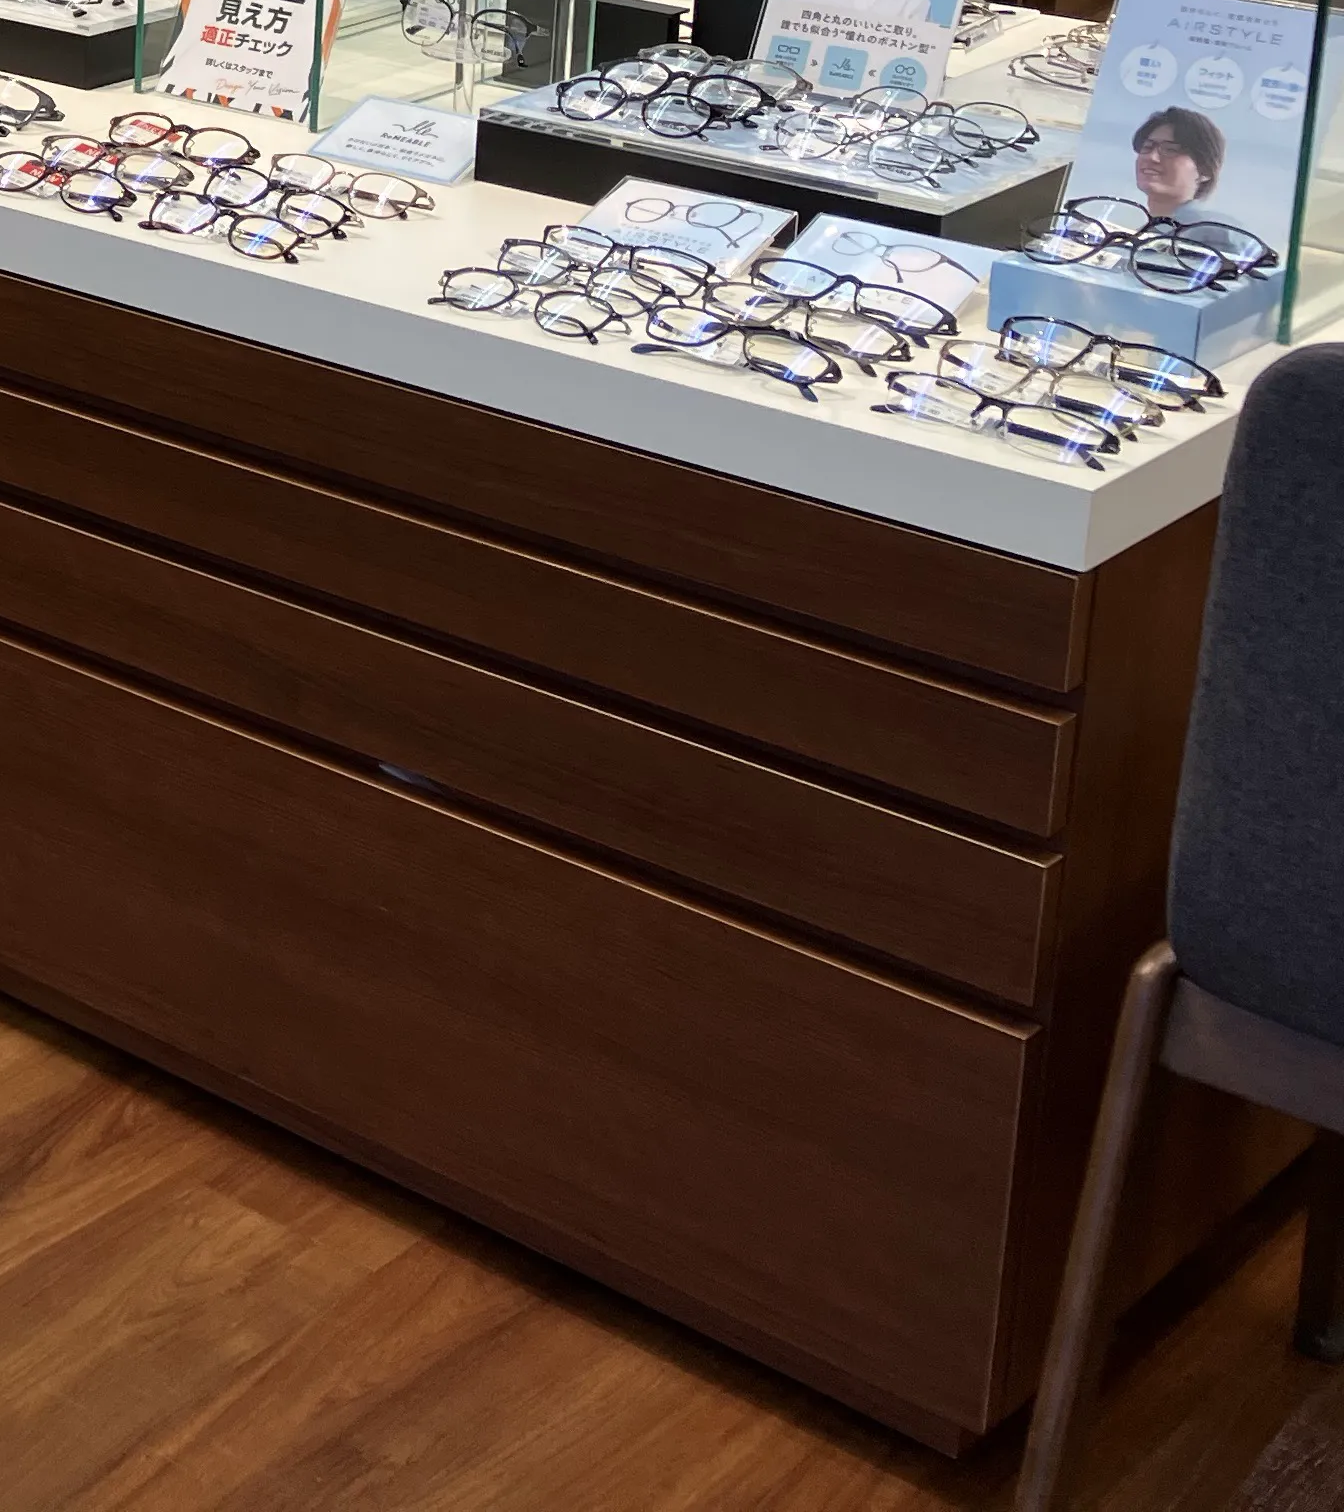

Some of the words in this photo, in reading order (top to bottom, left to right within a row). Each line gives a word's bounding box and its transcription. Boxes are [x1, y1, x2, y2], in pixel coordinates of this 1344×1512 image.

[200, 25, 294, 58] 適正チェック
[1166, 17, 1285, 47] AIRSTYLE
